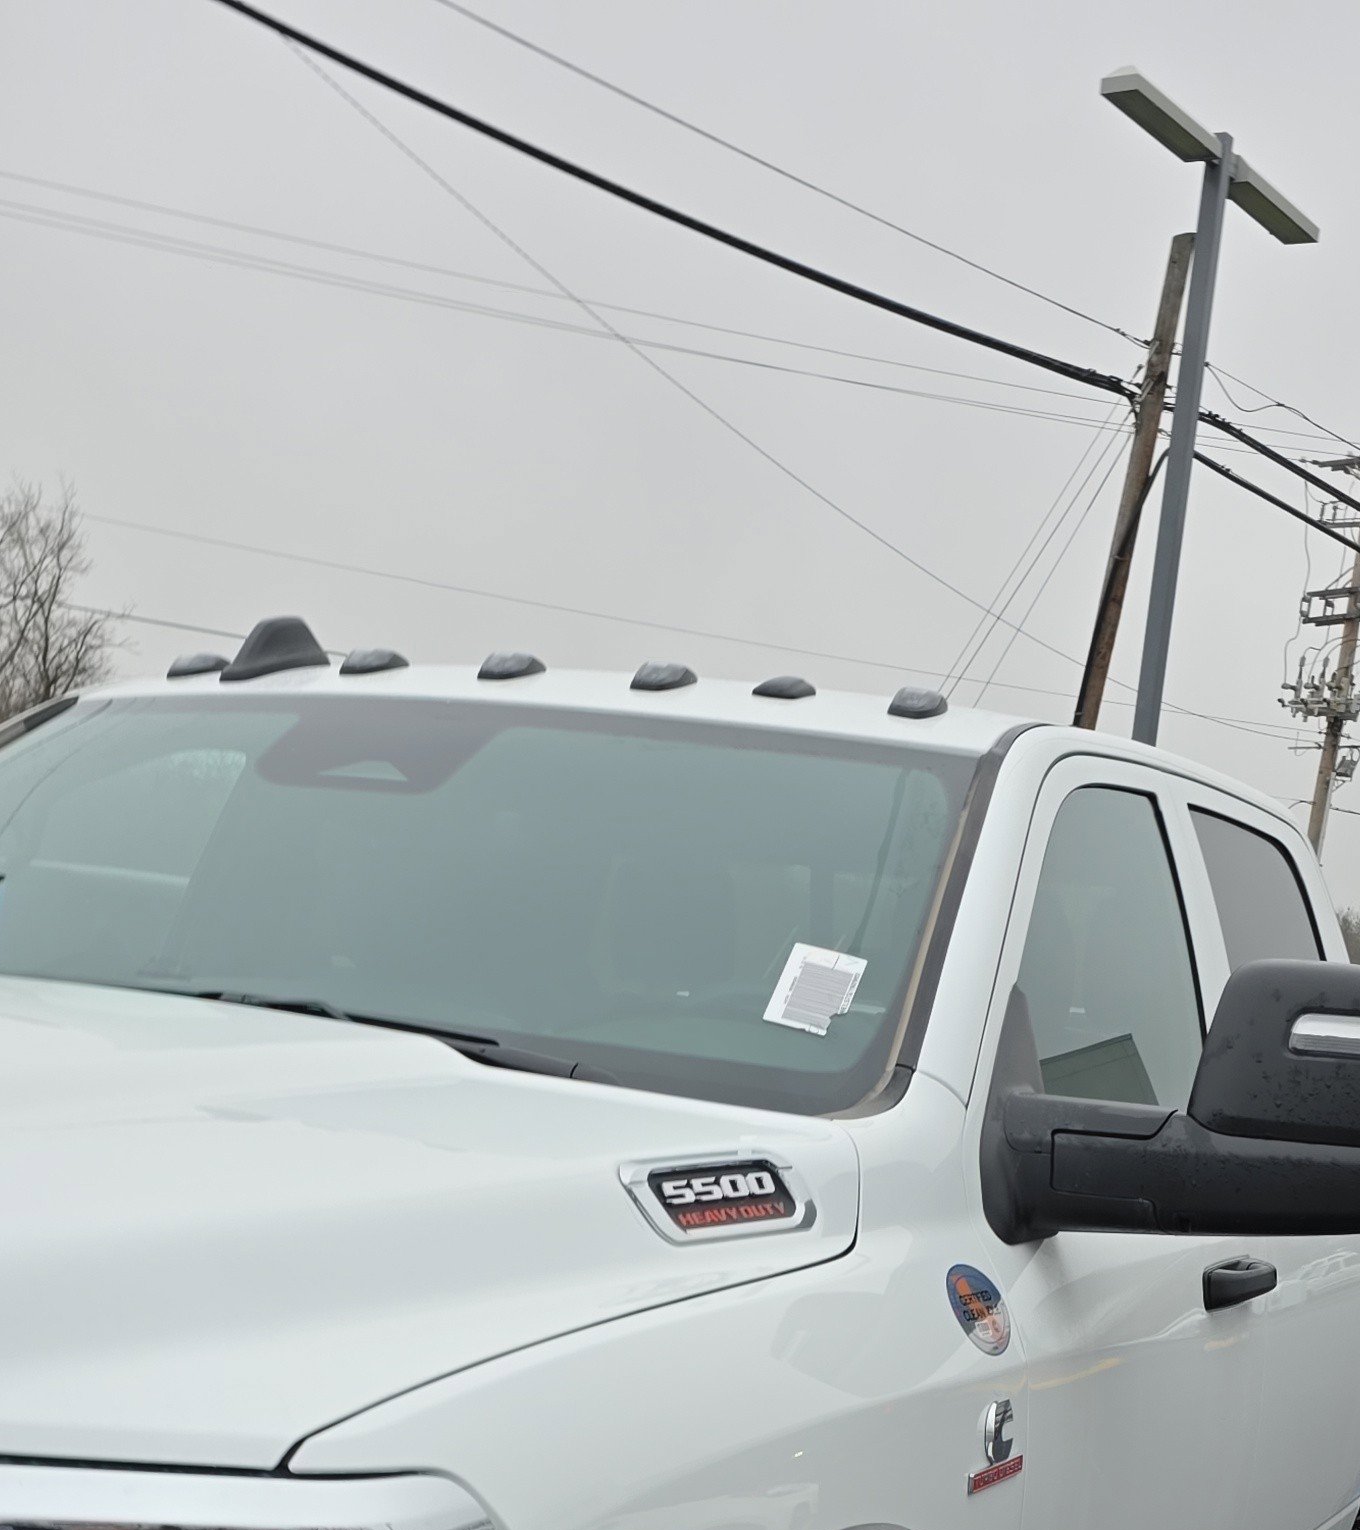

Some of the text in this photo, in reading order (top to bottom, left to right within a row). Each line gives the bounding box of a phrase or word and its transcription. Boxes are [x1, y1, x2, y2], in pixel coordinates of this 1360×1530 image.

[661, 1171, 776, 1205] 5500
[677, 1202, 785, 1227] HEAVY DUTY
